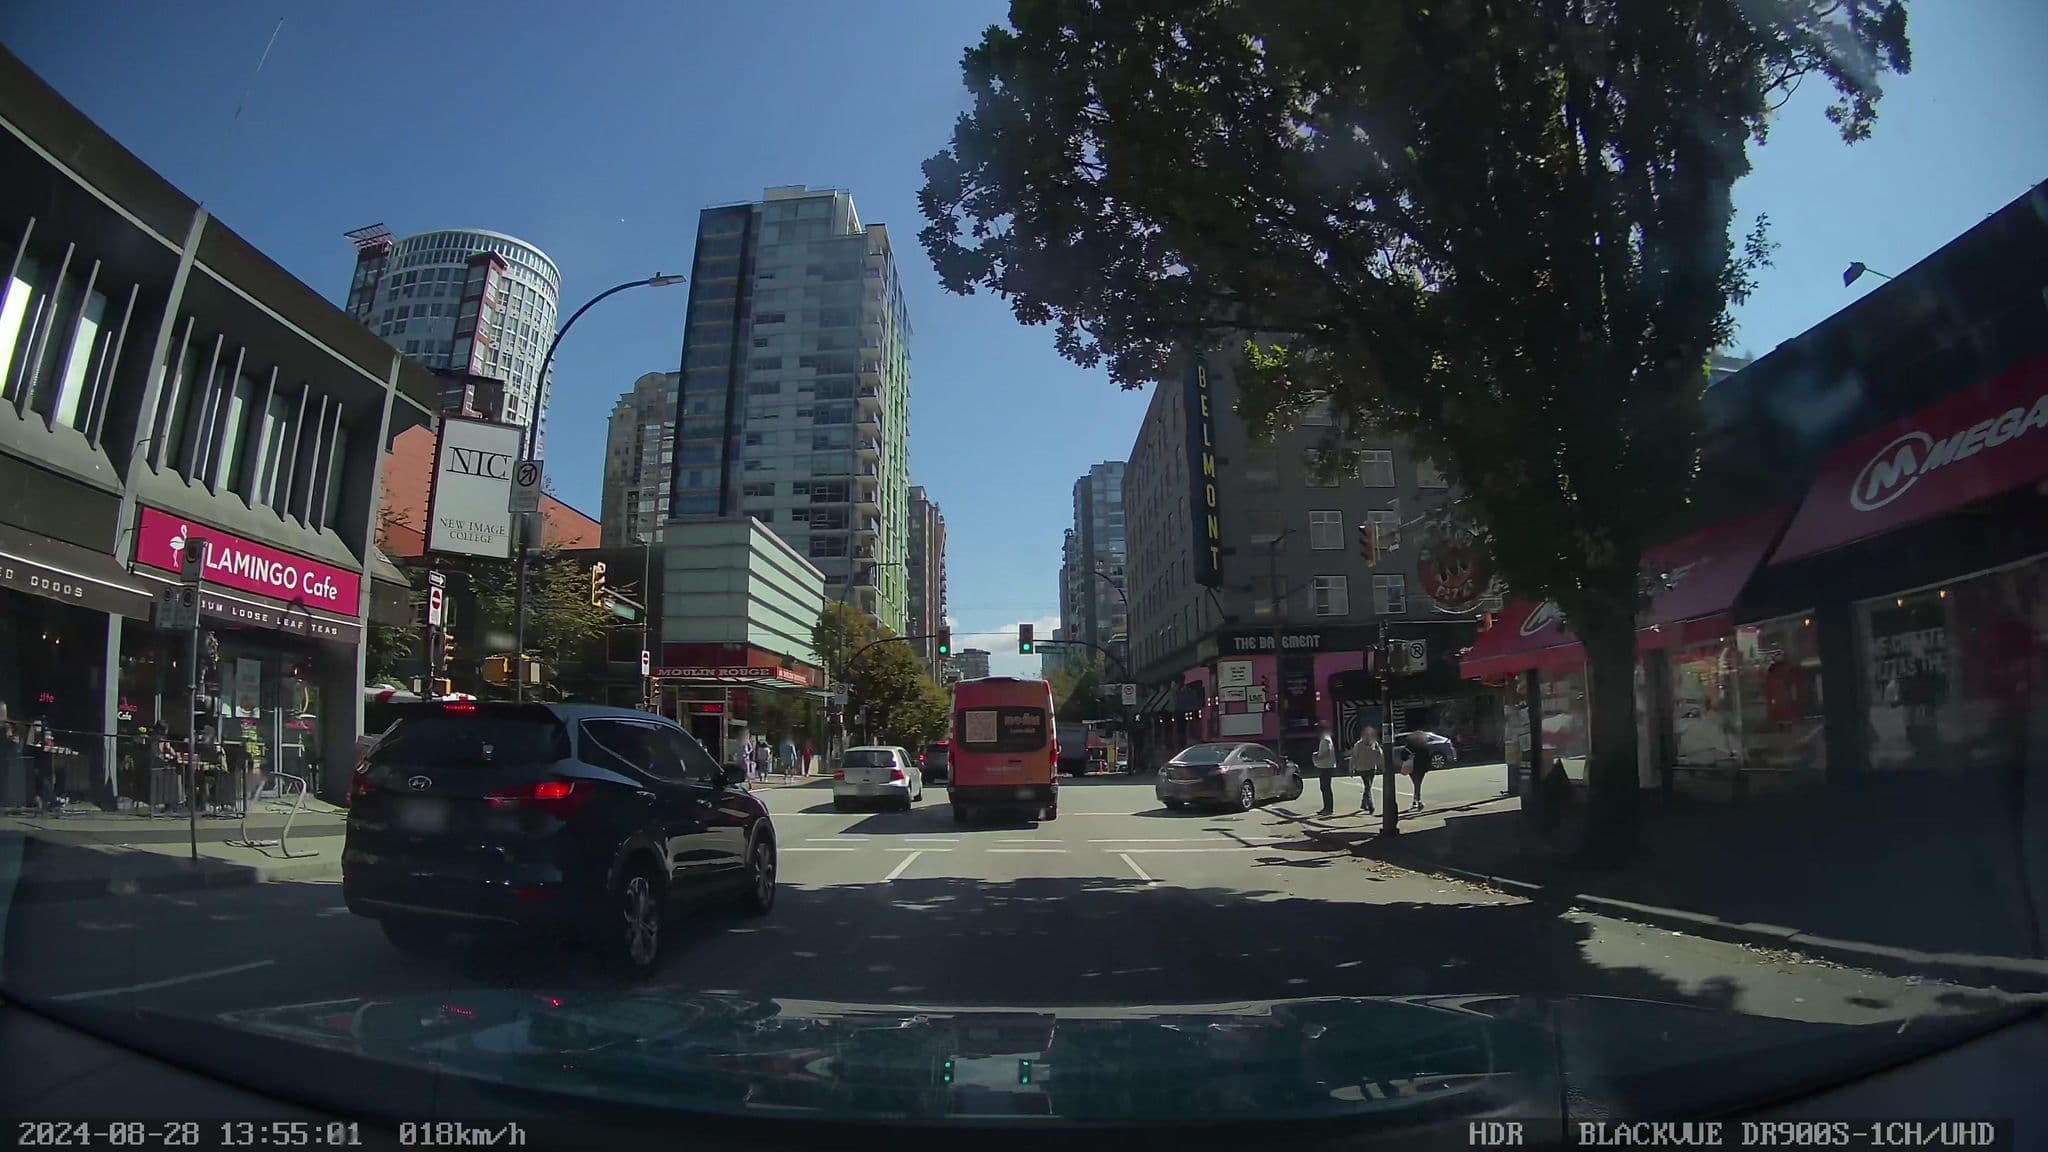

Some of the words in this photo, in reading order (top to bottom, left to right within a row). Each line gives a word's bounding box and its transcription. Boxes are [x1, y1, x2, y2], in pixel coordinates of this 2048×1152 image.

[1920, 394, 2048, 475] MEGA
[446, 446, 512, 480] NIC
[1197, 365, 1220, 571] BELMONT
[440, 517, 466, 531] NEW
[469, 521, 505, 535] IMAGE
[449, 531, 493, 544] COLLEGE
[203, 541, 298, 590] LAMINGO
[303, 571, 338, 601] Cafe
[31, 575, 83, 598] GOODS
[232, 608, 268, 622] LOOSE
[277, 617, 304, 630] LEAF
[312, 624, 338, 635] TEAS
[1233, 636, 1257, 649] THE
[1259, 634, 1321, 649] BAEMENT
[658, 668, 715, 677] MOULIN
[718, 668, 770, 677] ROUGE
